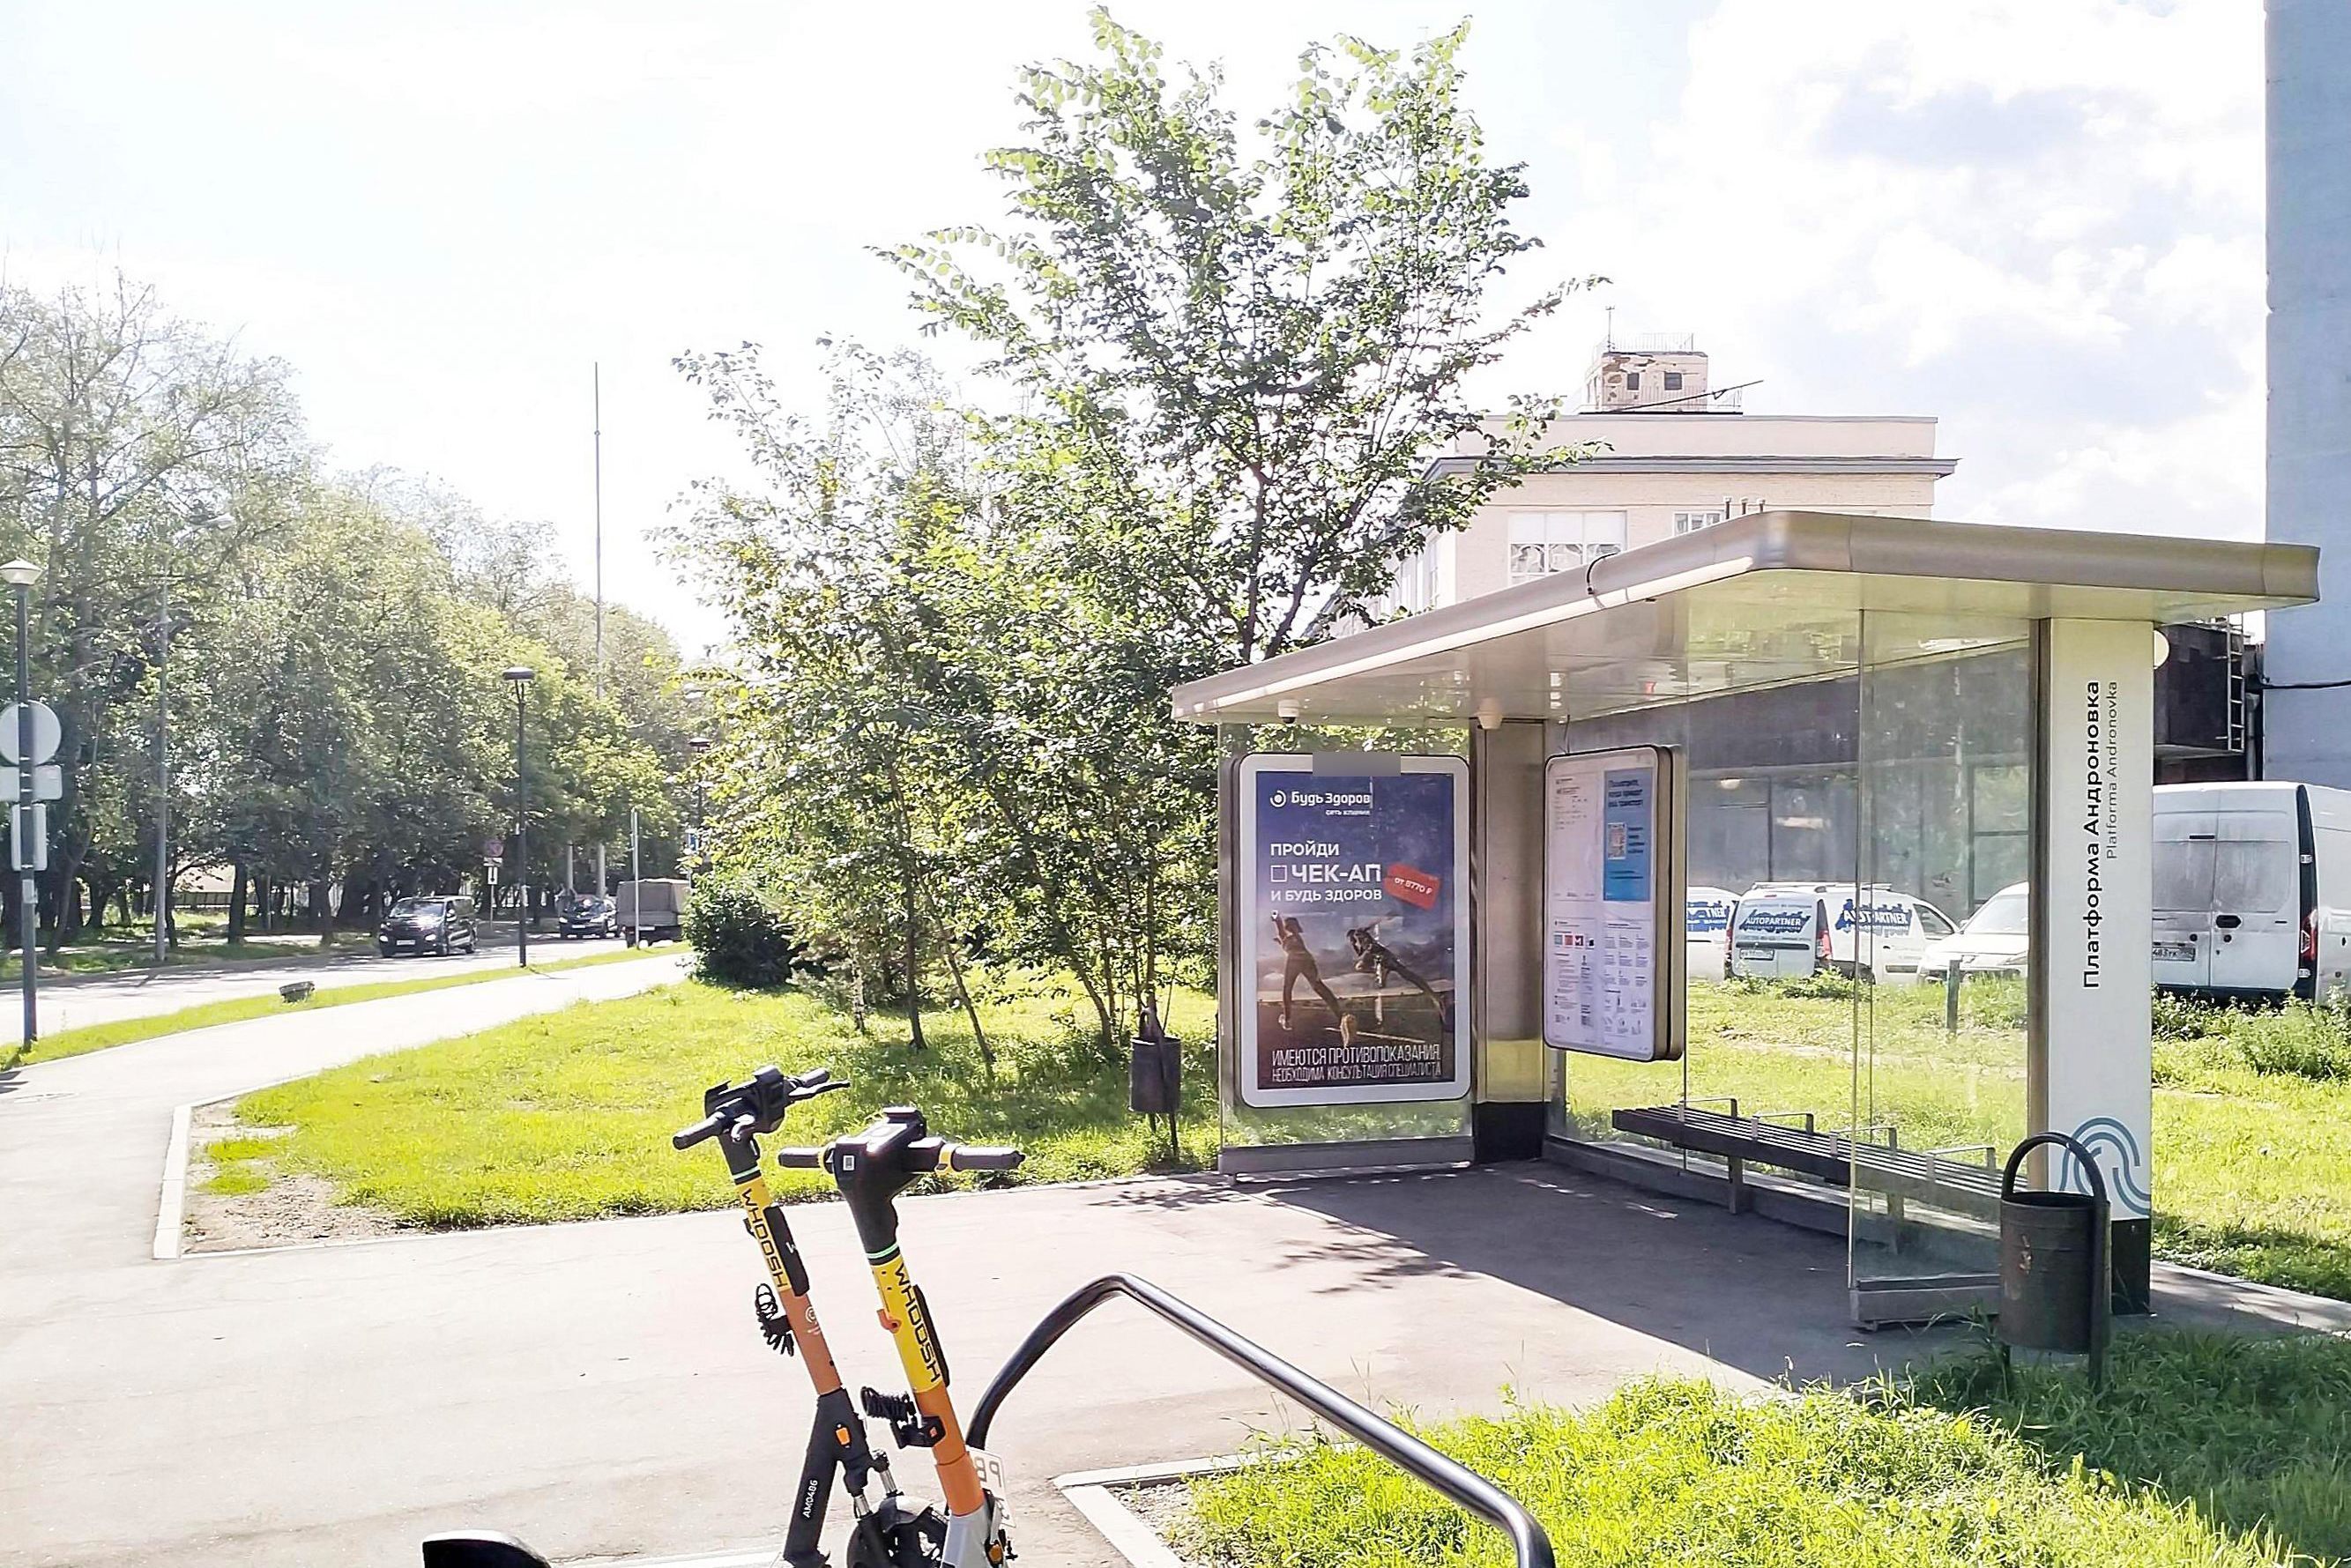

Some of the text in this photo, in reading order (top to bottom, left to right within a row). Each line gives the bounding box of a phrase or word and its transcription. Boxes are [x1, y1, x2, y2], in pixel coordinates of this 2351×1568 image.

[2106, 681, 2117, 859] Platforma Andronovka
[1291, 791, 1371, 806] Будь Здоров
[2082, 680, 2102, 988] Платформа Андроновка
[1270, 841, 1340, 858] ПРОЙДИ
[1291, 864, 1381, 883] ЧЕК-АП
[1270, 889, 1382, 903] И БУДЬ ЗДОРОВ
[1745, 917, 1802, 926] AUTOPARTNER
[1272, 1048, 1327, 1066] ИМЕЮТСЯ
[1272, 1061, 1441, 1082] НЕОБХОДИМА КОНСУЛЬТАЦИЯ СПЕЦИАЛИСТА
[741, 1188, 788, 1288] WHOOSH
[895, 1262, 941, 1382] WHOOSH
